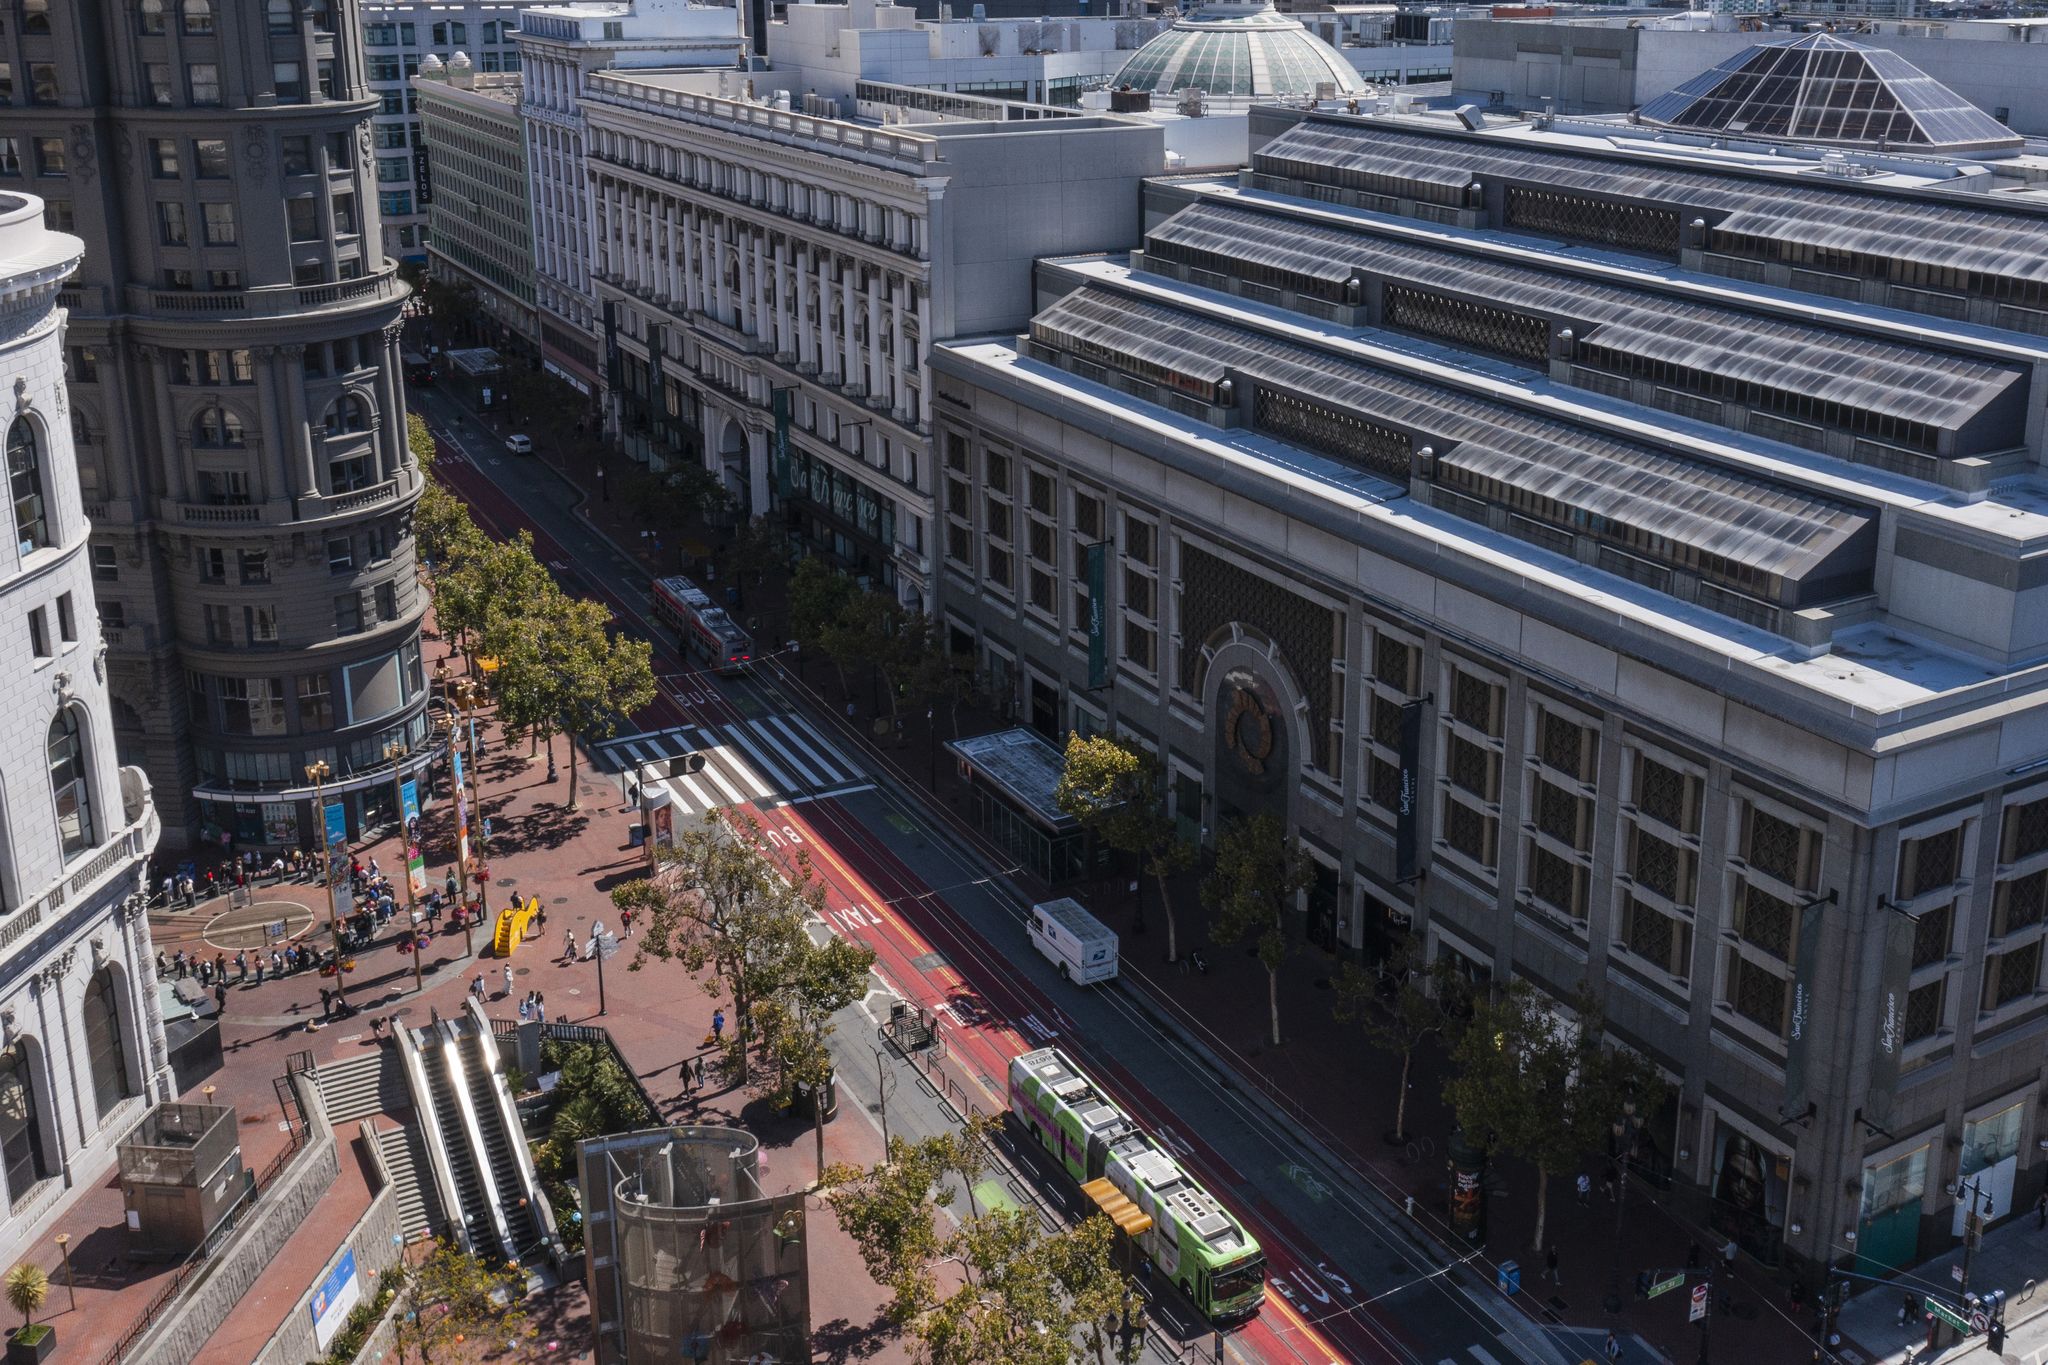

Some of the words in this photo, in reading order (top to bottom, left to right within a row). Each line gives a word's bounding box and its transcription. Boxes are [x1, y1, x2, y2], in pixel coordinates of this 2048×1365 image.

[419, 157, 428, 199] ZELOS
[674, 688, 721, 707] BUS
[829, 904, 883, 932] TAXI
[1270, 1262, 1353, 1314] BUS
[1934, 1305, 1961, 1327] Market
